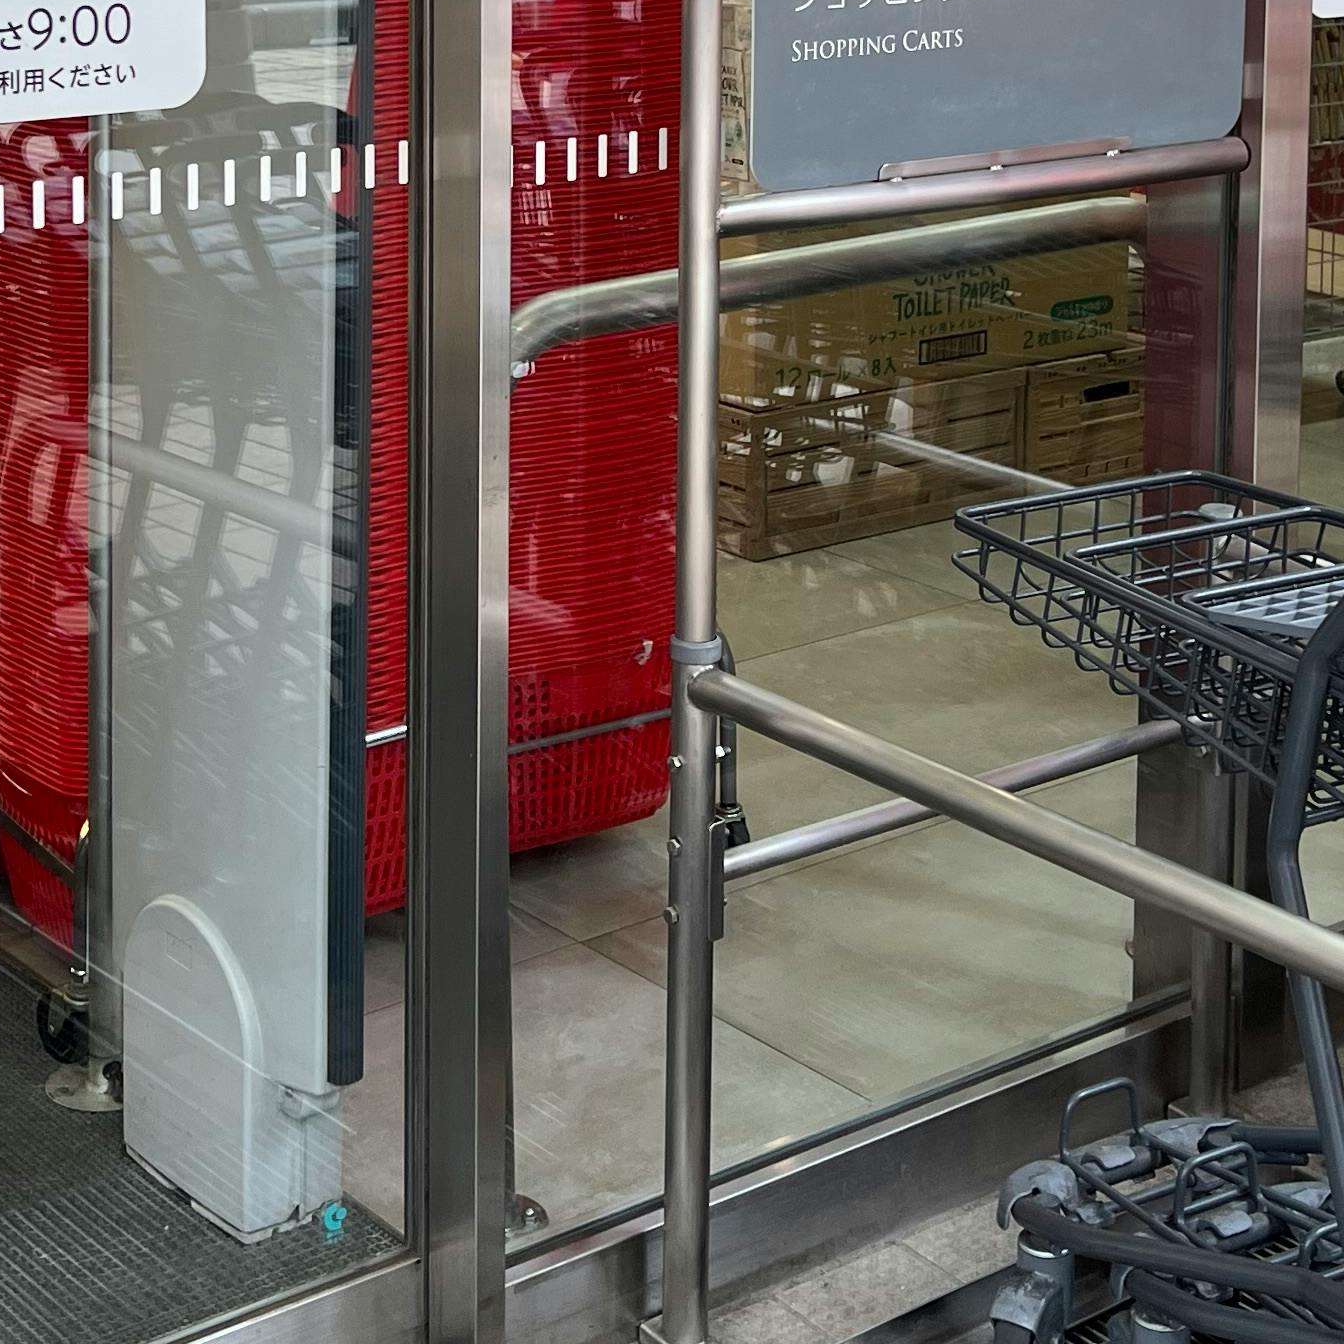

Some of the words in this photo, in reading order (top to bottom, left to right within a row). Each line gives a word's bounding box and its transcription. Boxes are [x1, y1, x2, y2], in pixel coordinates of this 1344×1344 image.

[790, 32, 897, 64] SHOPPING
[901, 27, 965, 54] CARTS
[892, 287, 956, 322] TOILET
[958, 277, 1017, 311] PAPER
